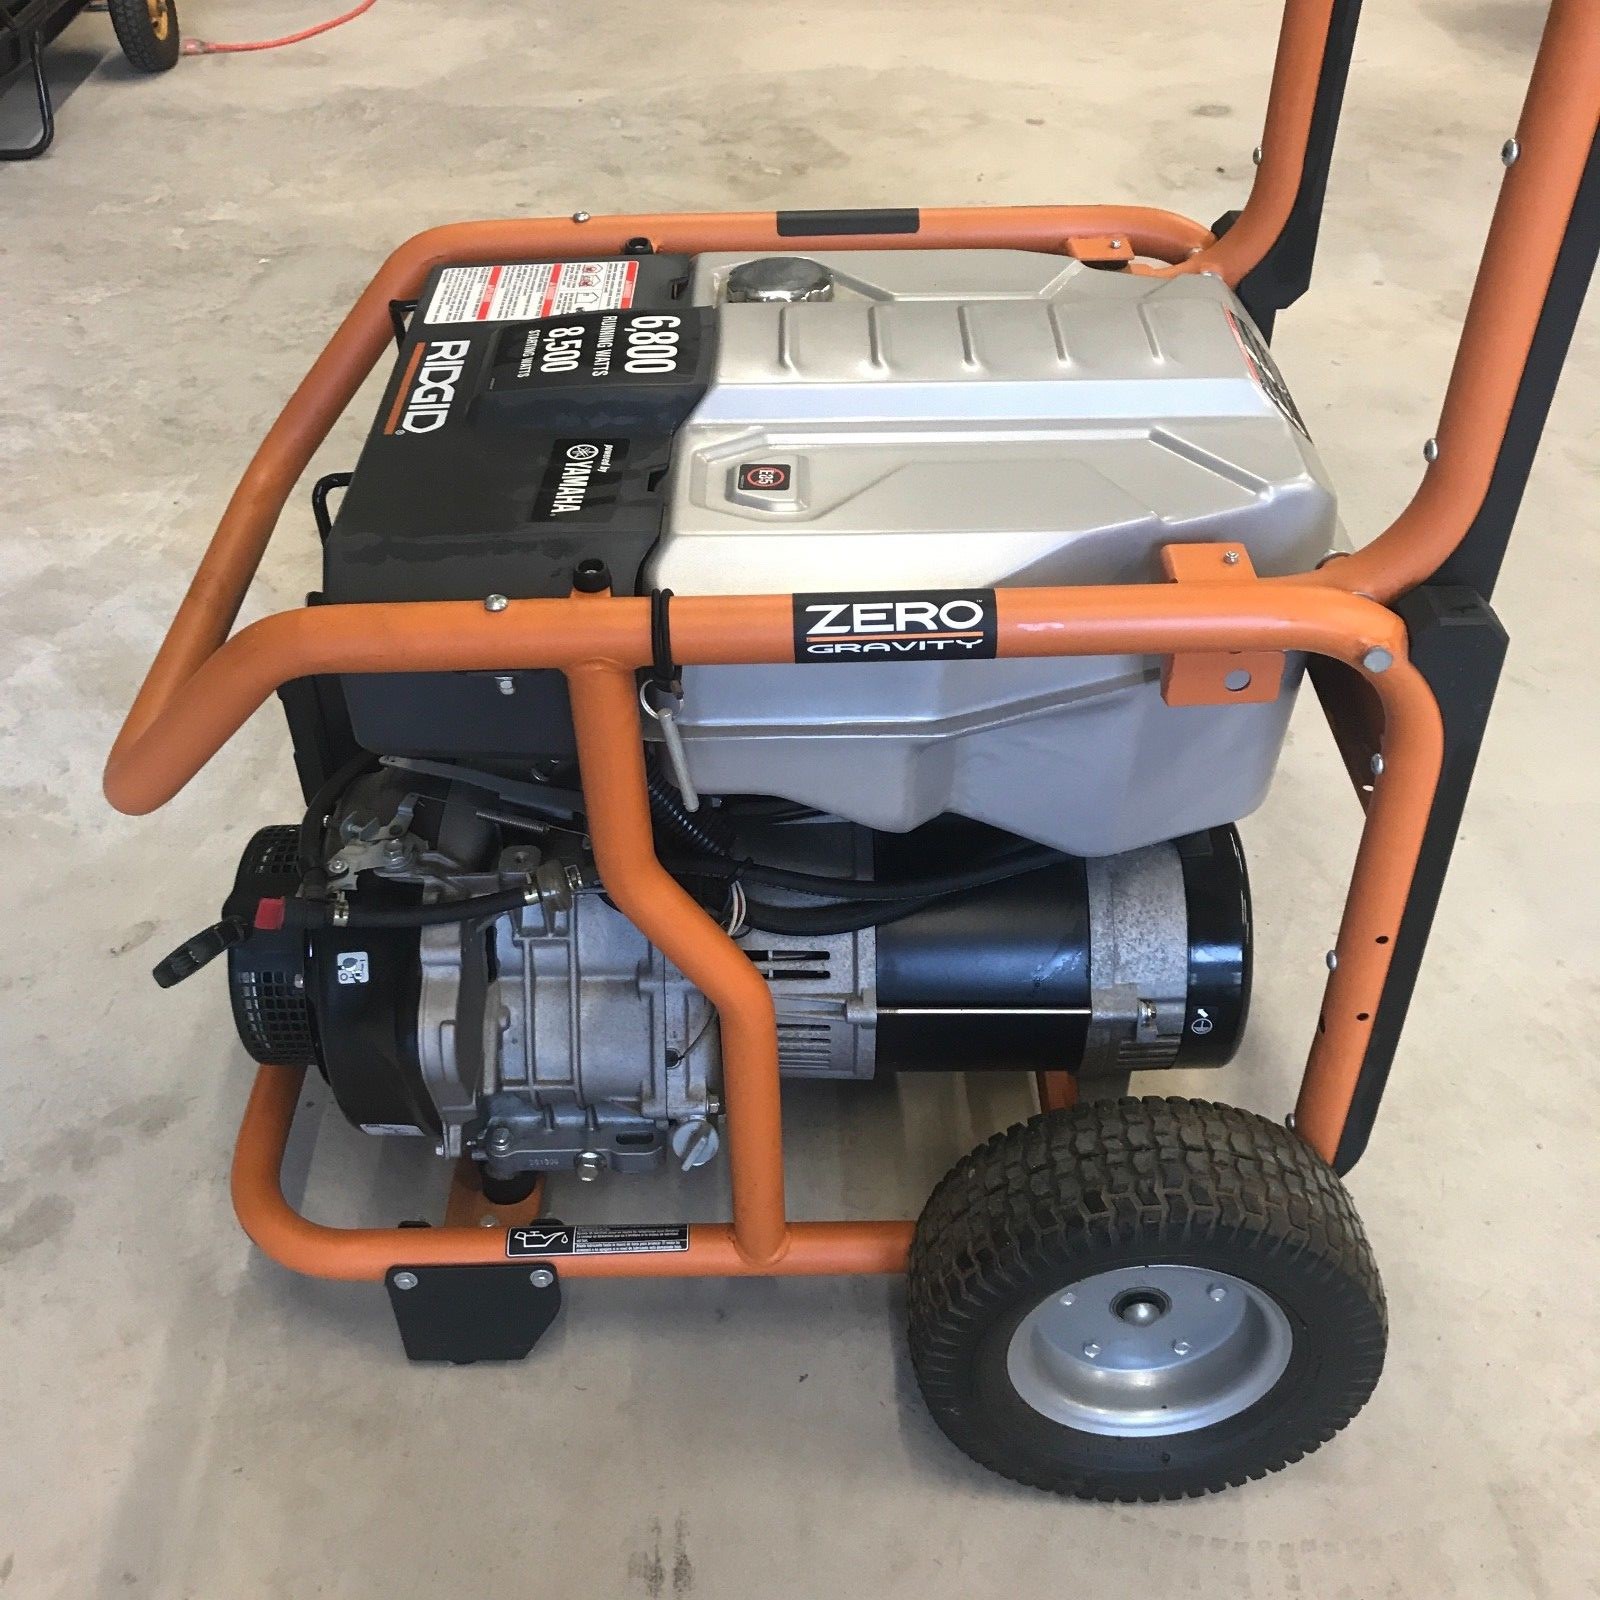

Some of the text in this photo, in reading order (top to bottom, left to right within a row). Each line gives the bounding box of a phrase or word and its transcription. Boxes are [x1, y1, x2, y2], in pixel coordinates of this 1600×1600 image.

[540, 326, 585, 373] 8,500
[597, 315, 618, 348] RUNNING
[624, 315, 681, 374] 6,800
[517, 329, 541, 378] STARTING WATTS
[592, 348, 612, 377] WATTS
[402, 340, 471, 433] RIDGID
[597, 443, 614, 473] powered by
[551, 460, 594, 513] YAMAHA
[805, 600, 984, 635] ZERO
[806, 638, 984, 654] GRAVITY
